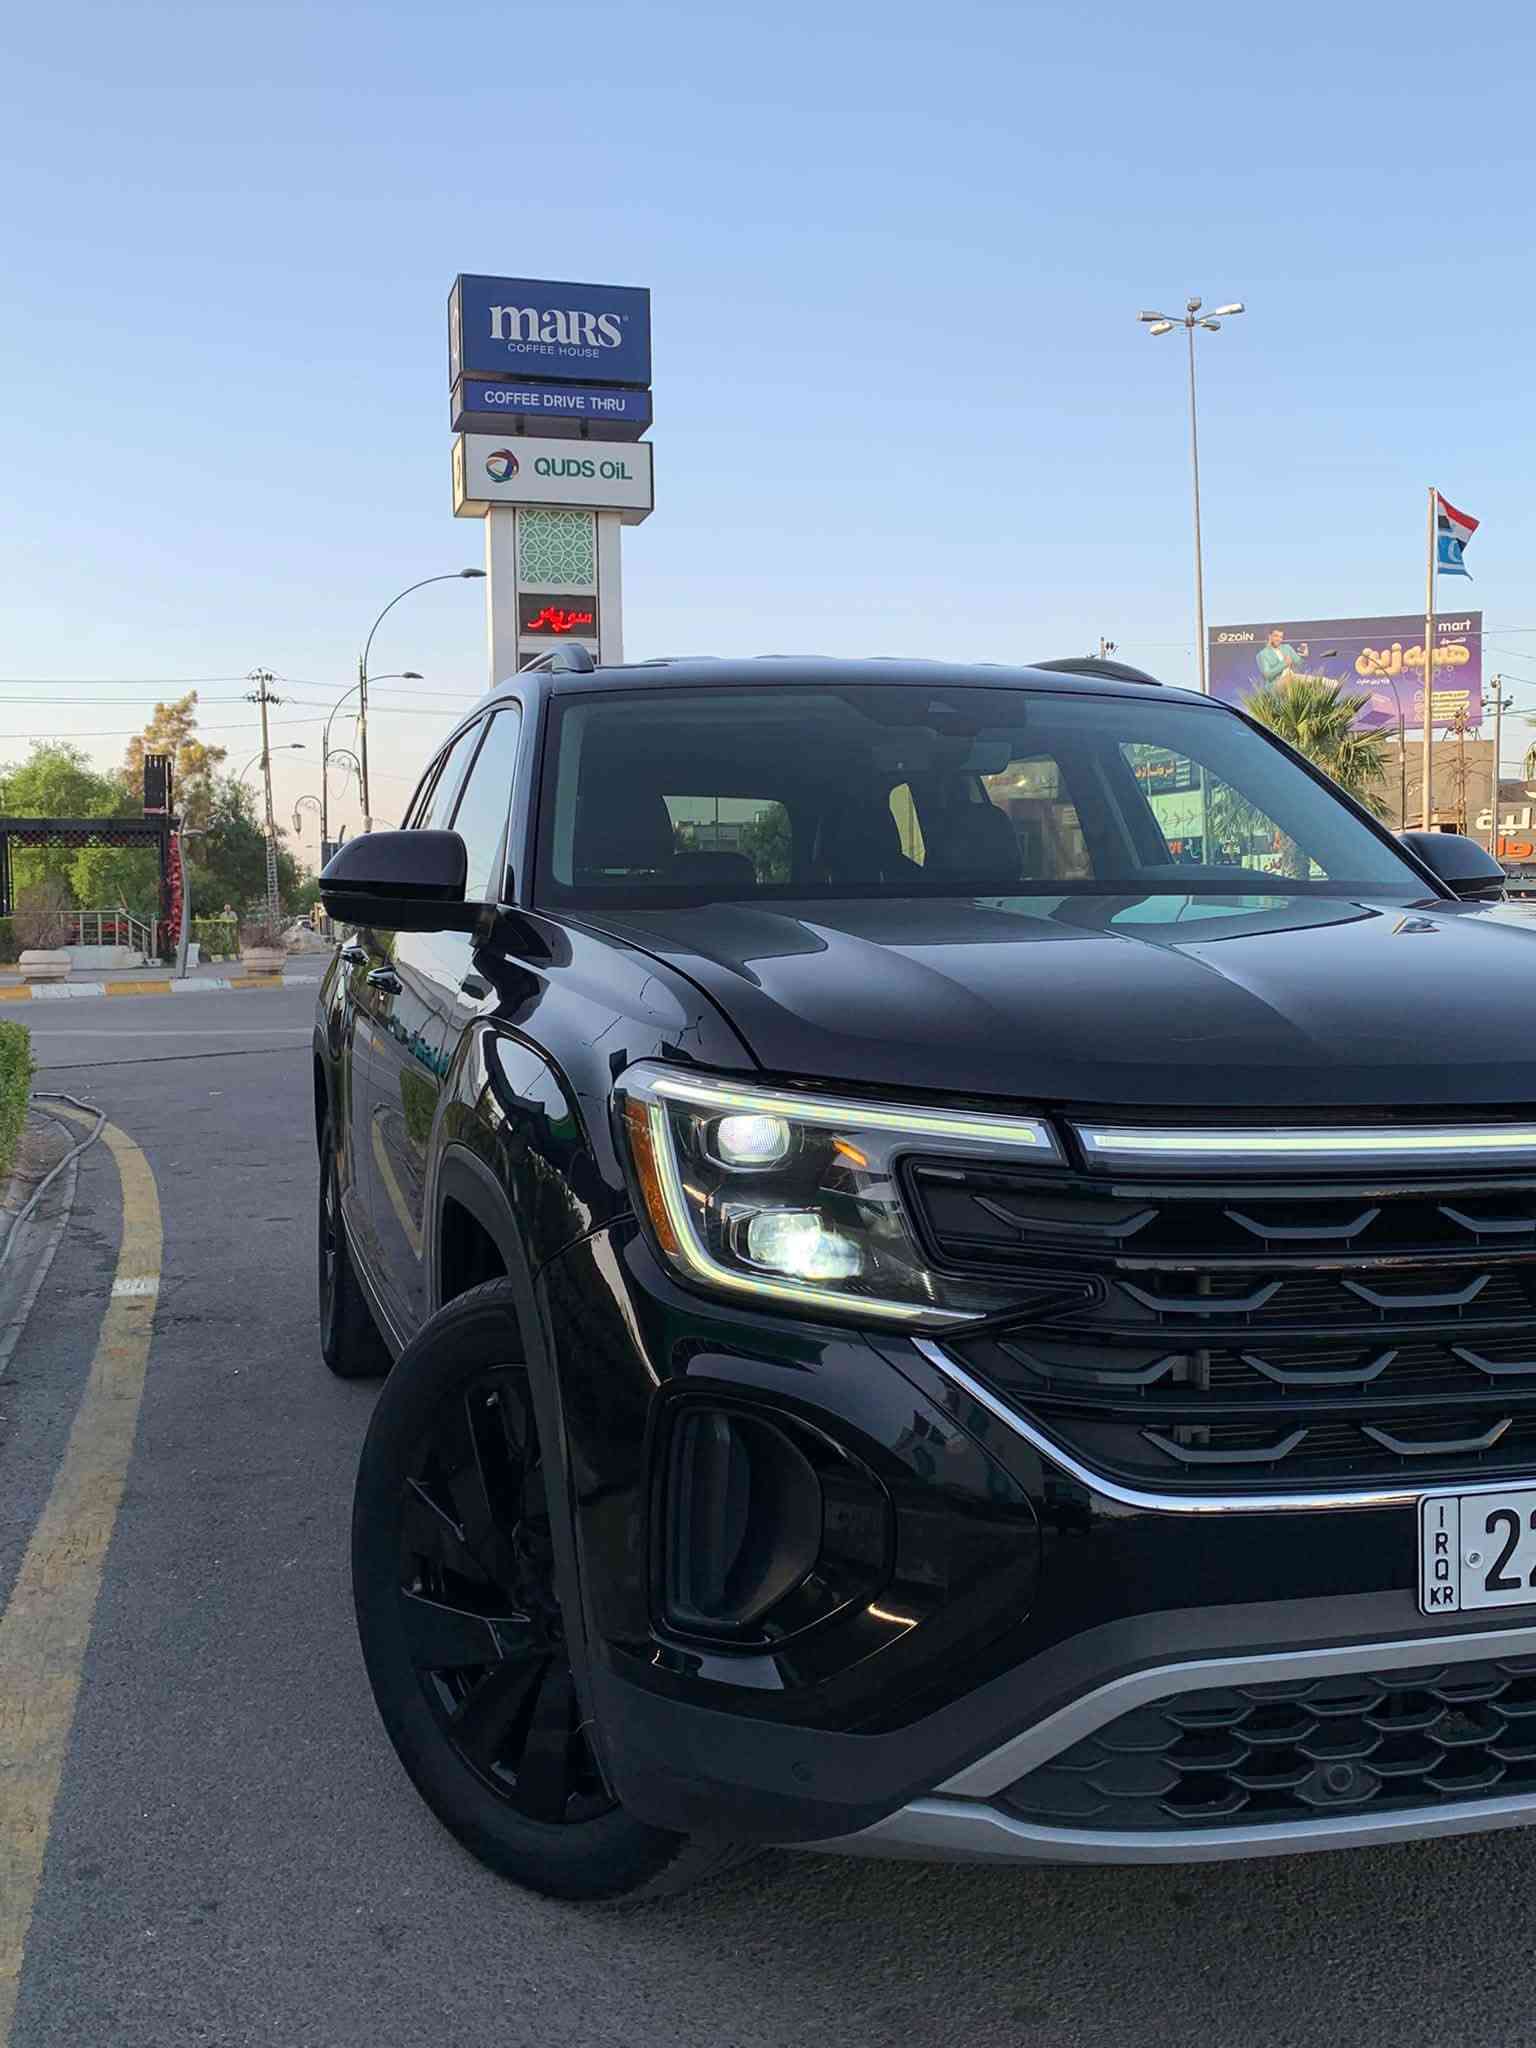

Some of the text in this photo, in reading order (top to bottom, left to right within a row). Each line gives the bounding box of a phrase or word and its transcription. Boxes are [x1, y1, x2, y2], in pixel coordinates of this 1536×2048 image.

[507, 342, 600, 358] COFFEE HOUSE
[484, 390, 625, 412] COFFEE DRIVE THRU
[534, 456, 595, 478] QUDS
[1438, 619, 1471, 633] mart
[1434, 1506, 1449, 1581] IRQ
[1430, 1586, 1454, 1606] KR
